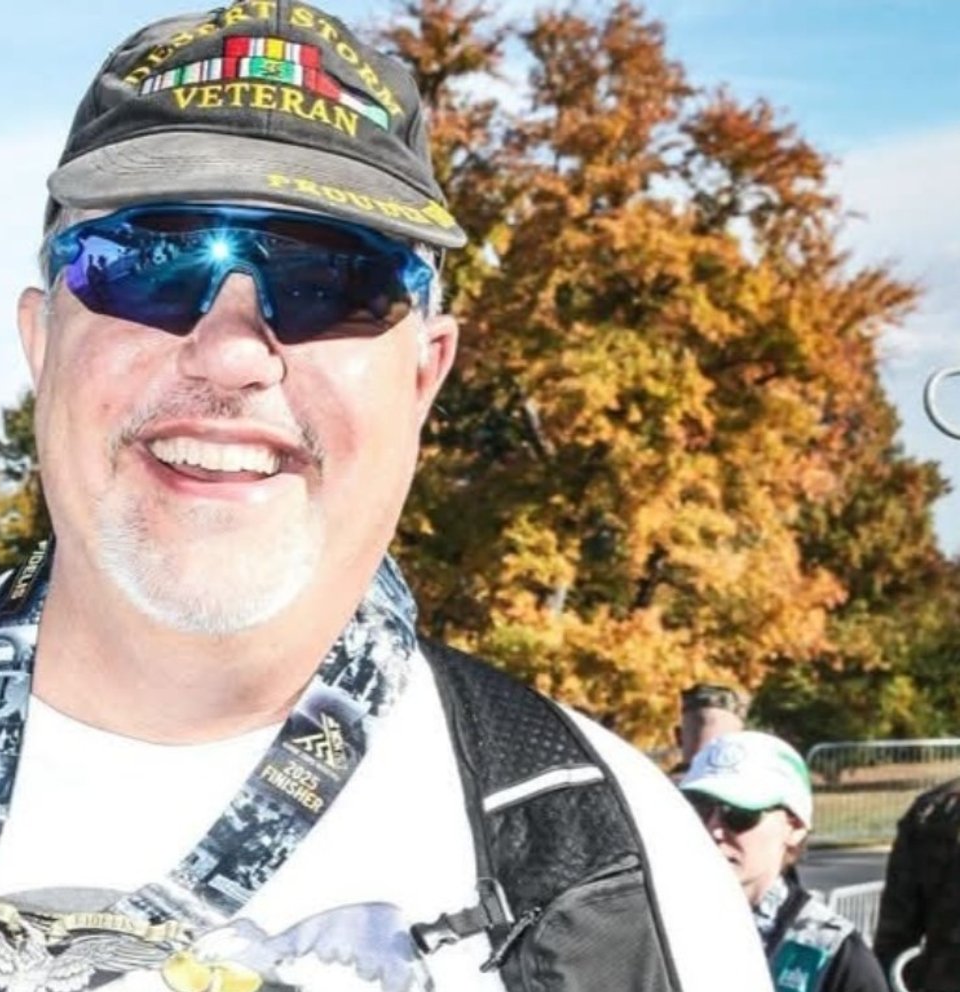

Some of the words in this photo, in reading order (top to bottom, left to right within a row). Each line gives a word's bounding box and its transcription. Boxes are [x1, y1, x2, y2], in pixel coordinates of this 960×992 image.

[123, 1, 276, 84] DESERT
[289, 7, 405, 116] STORM
[173, 83, 359, 137] VETERAN
[261, 764, 324, 814] FINISHER
[283, 760, 321, 791] 2025
